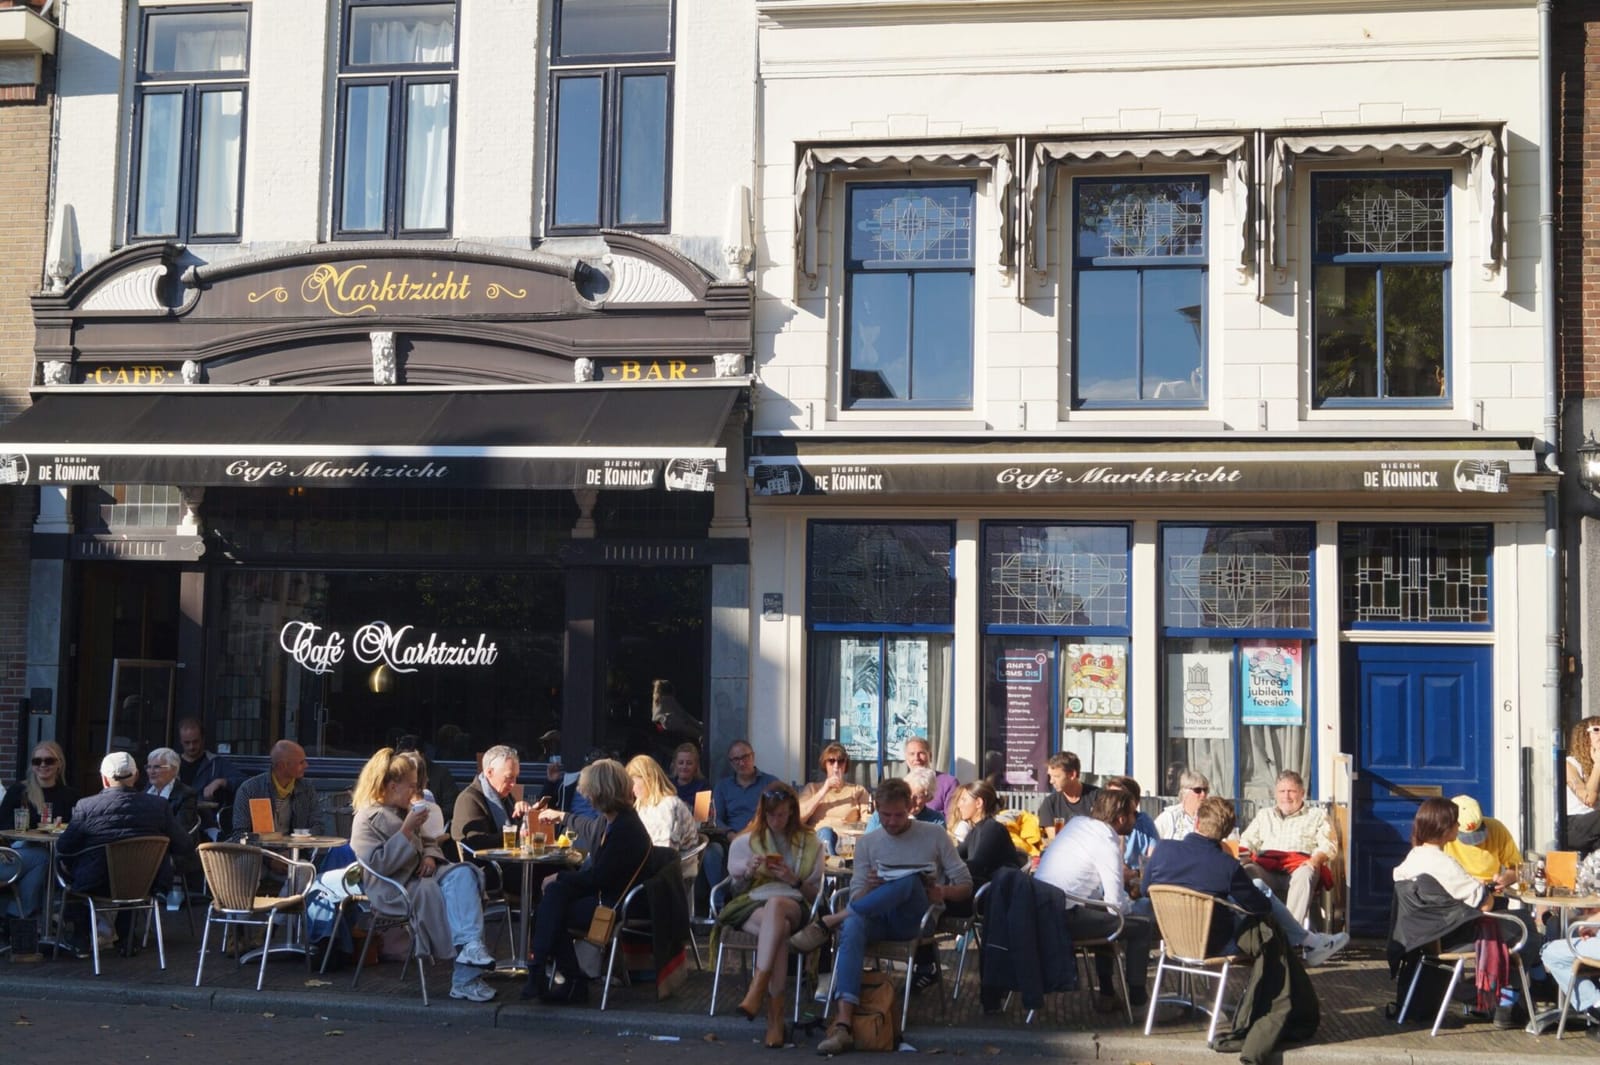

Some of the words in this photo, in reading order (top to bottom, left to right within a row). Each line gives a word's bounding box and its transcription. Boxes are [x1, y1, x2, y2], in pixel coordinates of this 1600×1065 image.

[301, 264, 471, 316] Marktzicht
[620, 360, 688, 381] BAR
[39, 465, 53, 481] DE
[55, 464, 100, 481] KONINCK
[225, 460, 287, 482] Café
[289, 461, 448, 478] Marktzicht
[586, 468, 601, 485] DE
[604, 467, 655, 486] KONINCK
[996, 467, 1064, 490] Café
[1066, 466, 1242, 484] Marktzicht
[1363, 471, 1379, 487] DE
[1382, 470, 1438, 487] KONINCK
[814, 475, 829, 491] DE
[831, 473, 882, 491] KONINCK
[280, 620, 345, 675] Café
[352, 620, 498, 673] Marktzicht
[1247, 687, 1294, 699] jubileum
[1503, 699, 1513, 712] 6
